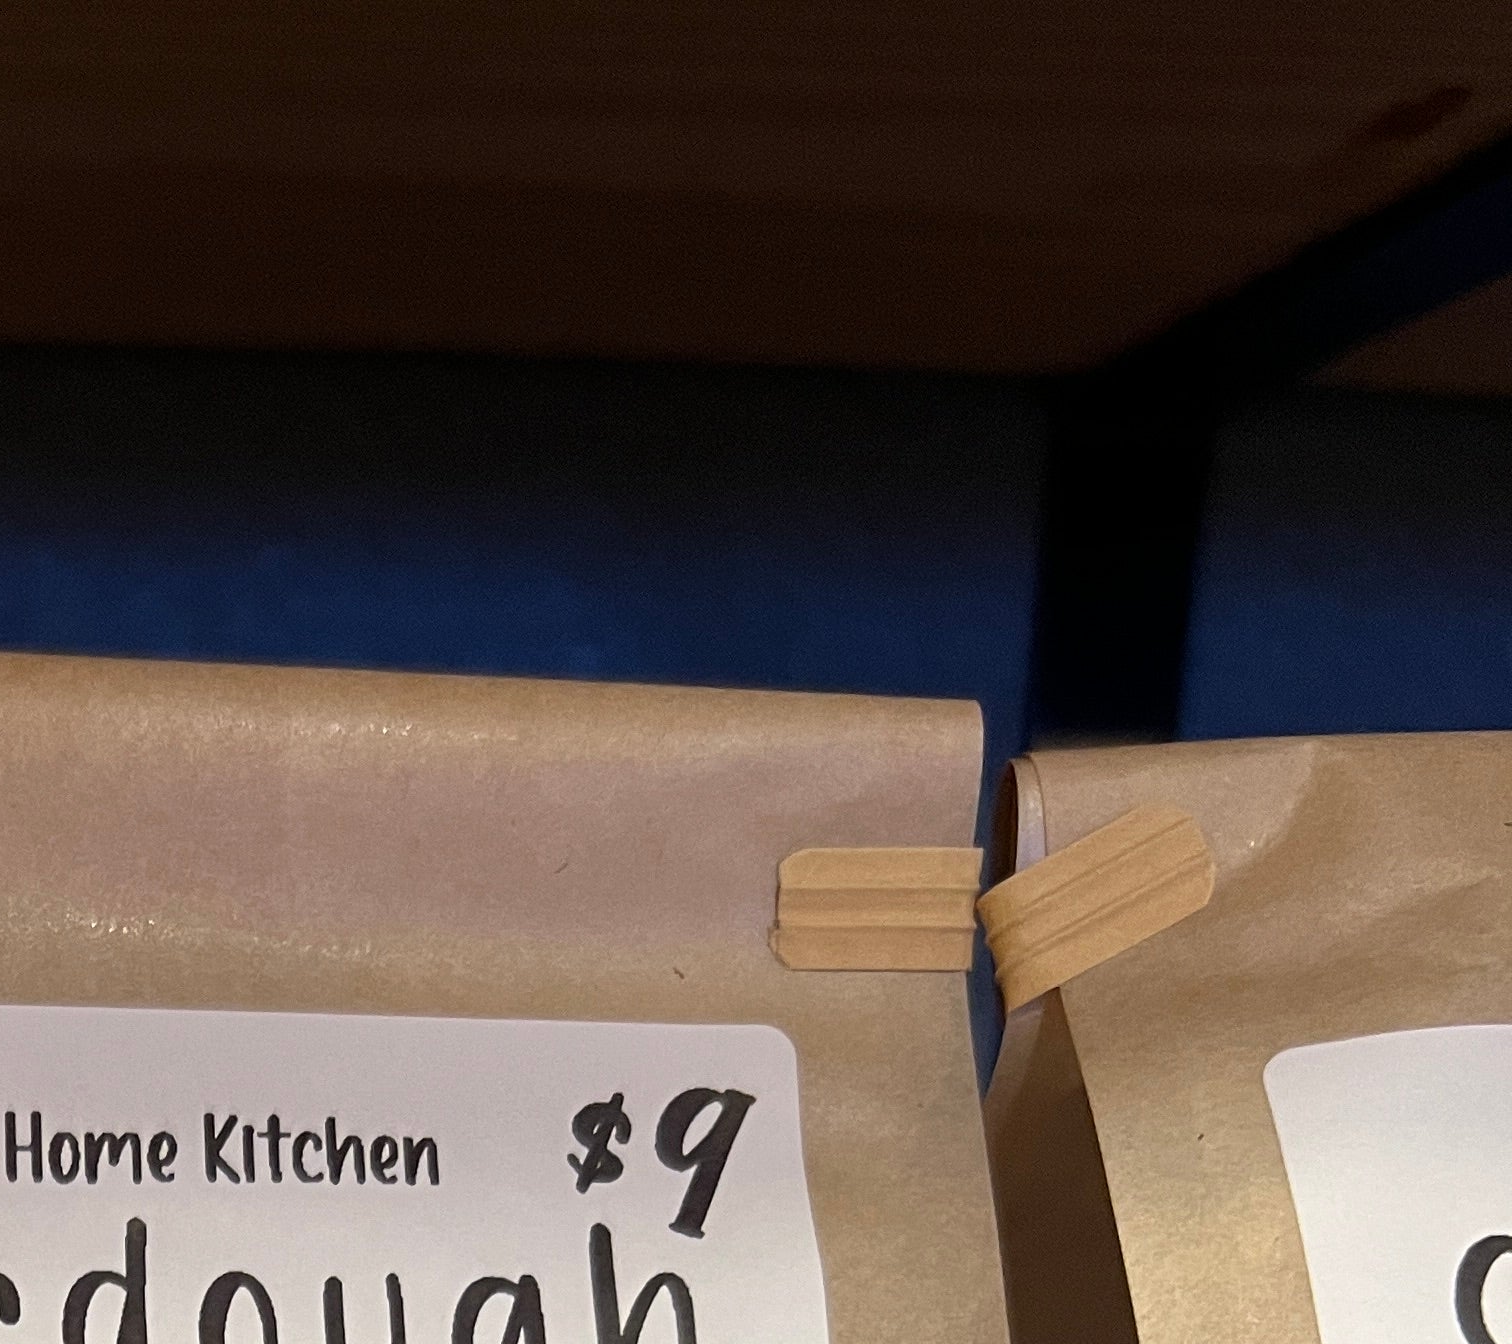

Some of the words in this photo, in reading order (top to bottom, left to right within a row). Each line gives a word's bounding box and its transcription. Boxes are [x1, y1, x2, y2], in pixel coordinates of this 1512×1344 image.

[4, 1110, 179, 1185] Home
[203, 1111, 441, 1187] Kitchen
[566, 1086, 757, 1240] $9
